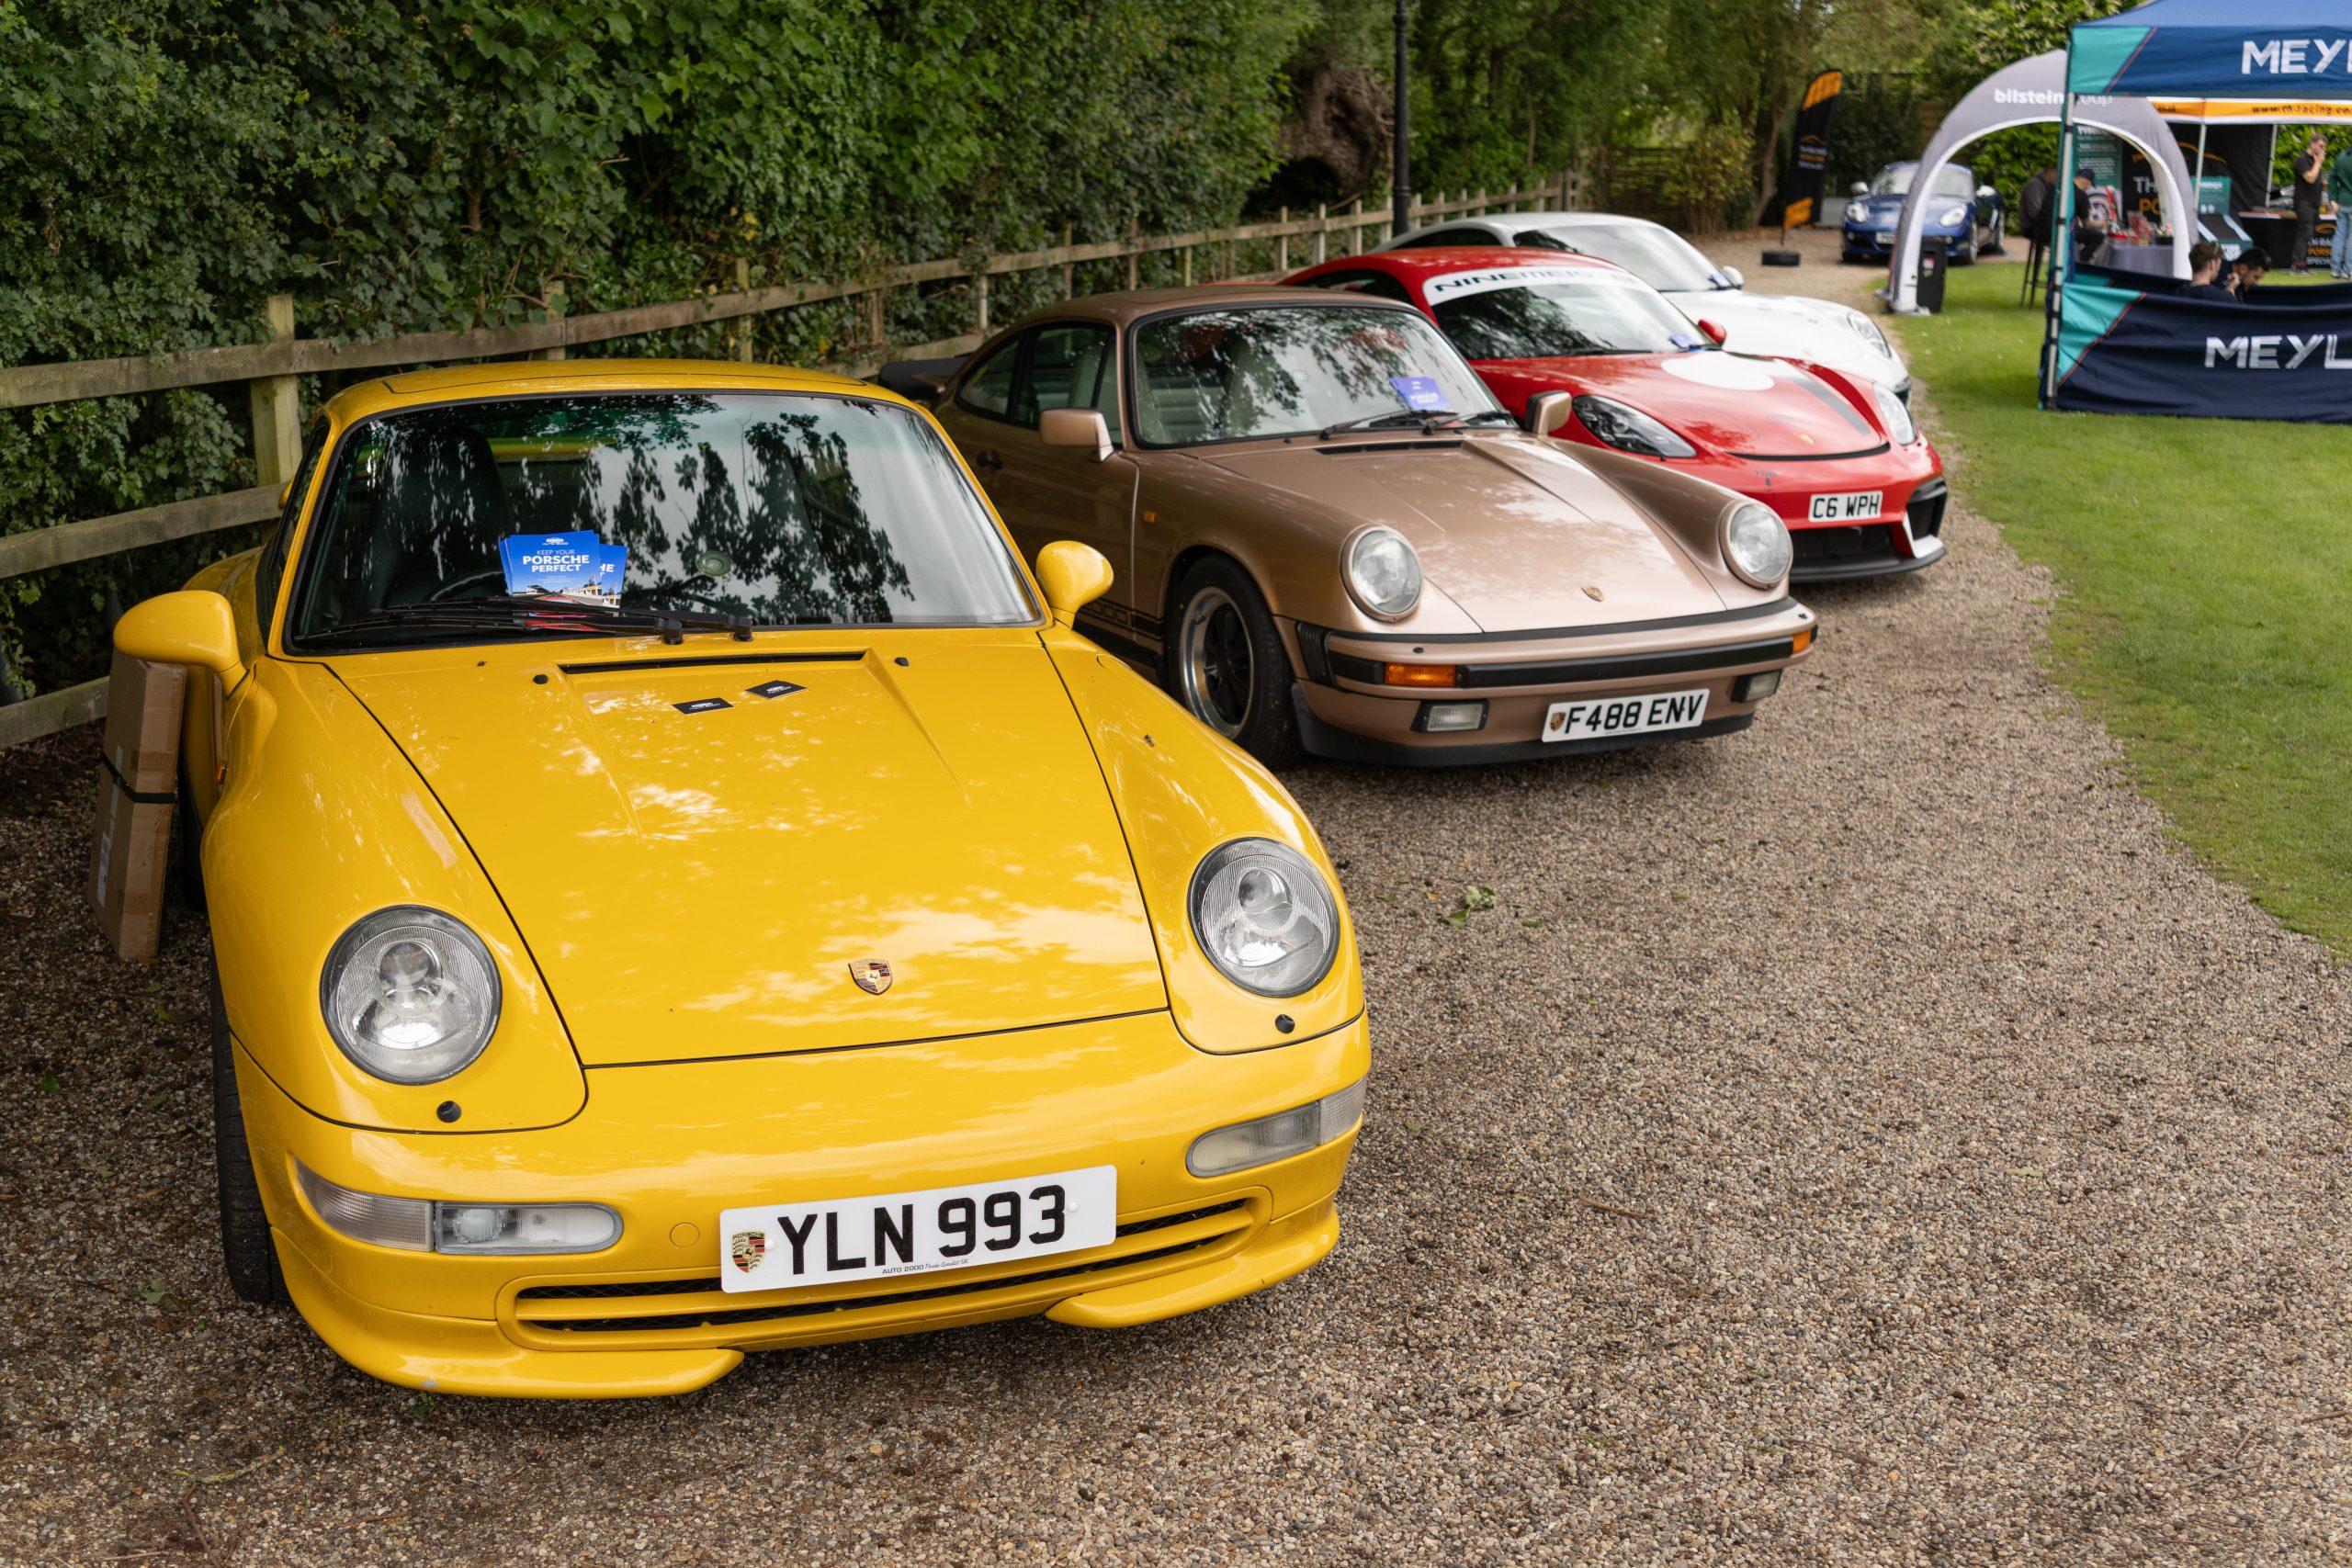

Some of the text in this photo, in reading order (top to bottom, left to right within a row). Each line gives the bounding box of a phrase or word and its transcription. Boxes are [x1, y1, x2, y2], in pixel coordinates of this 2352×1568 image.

[1813, 494, 1881, 519] C6 WPH
[522, 555, 590, 565] PORSCHE
[531, 564, 582, 573] PERFECT
[1565, 694, 1704, 734] F488 ENV
[777, 1184, 1066, 1275] YLN 993
[882, 1267, 902, 1275] AUTO
[904, 1264, 924, 1272] 2000
